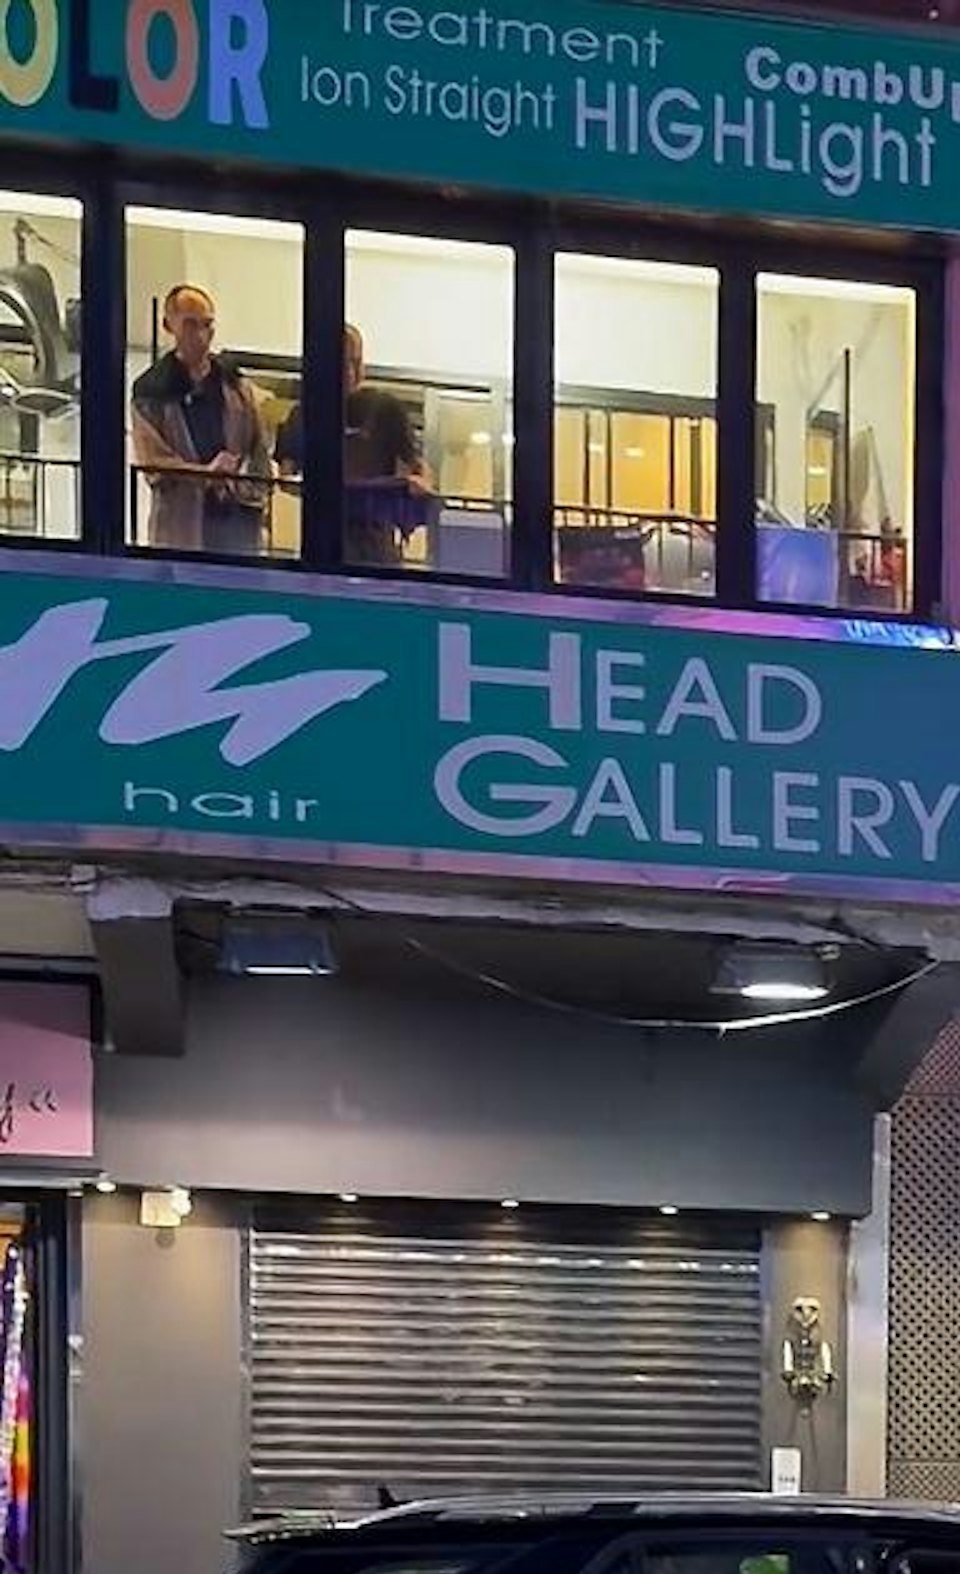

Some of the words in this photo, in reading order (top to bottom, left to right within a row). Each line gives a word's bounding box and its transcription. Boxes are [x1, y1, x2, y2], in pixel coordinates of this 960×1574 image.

[301, 54, 371, 110] Ion
[383, 64, 557, 137] Straight
[575, 76, 936, 198] HIGHLight
[437, 621, 823, 746] HEAD
[123, 781, 320, 822] hair
